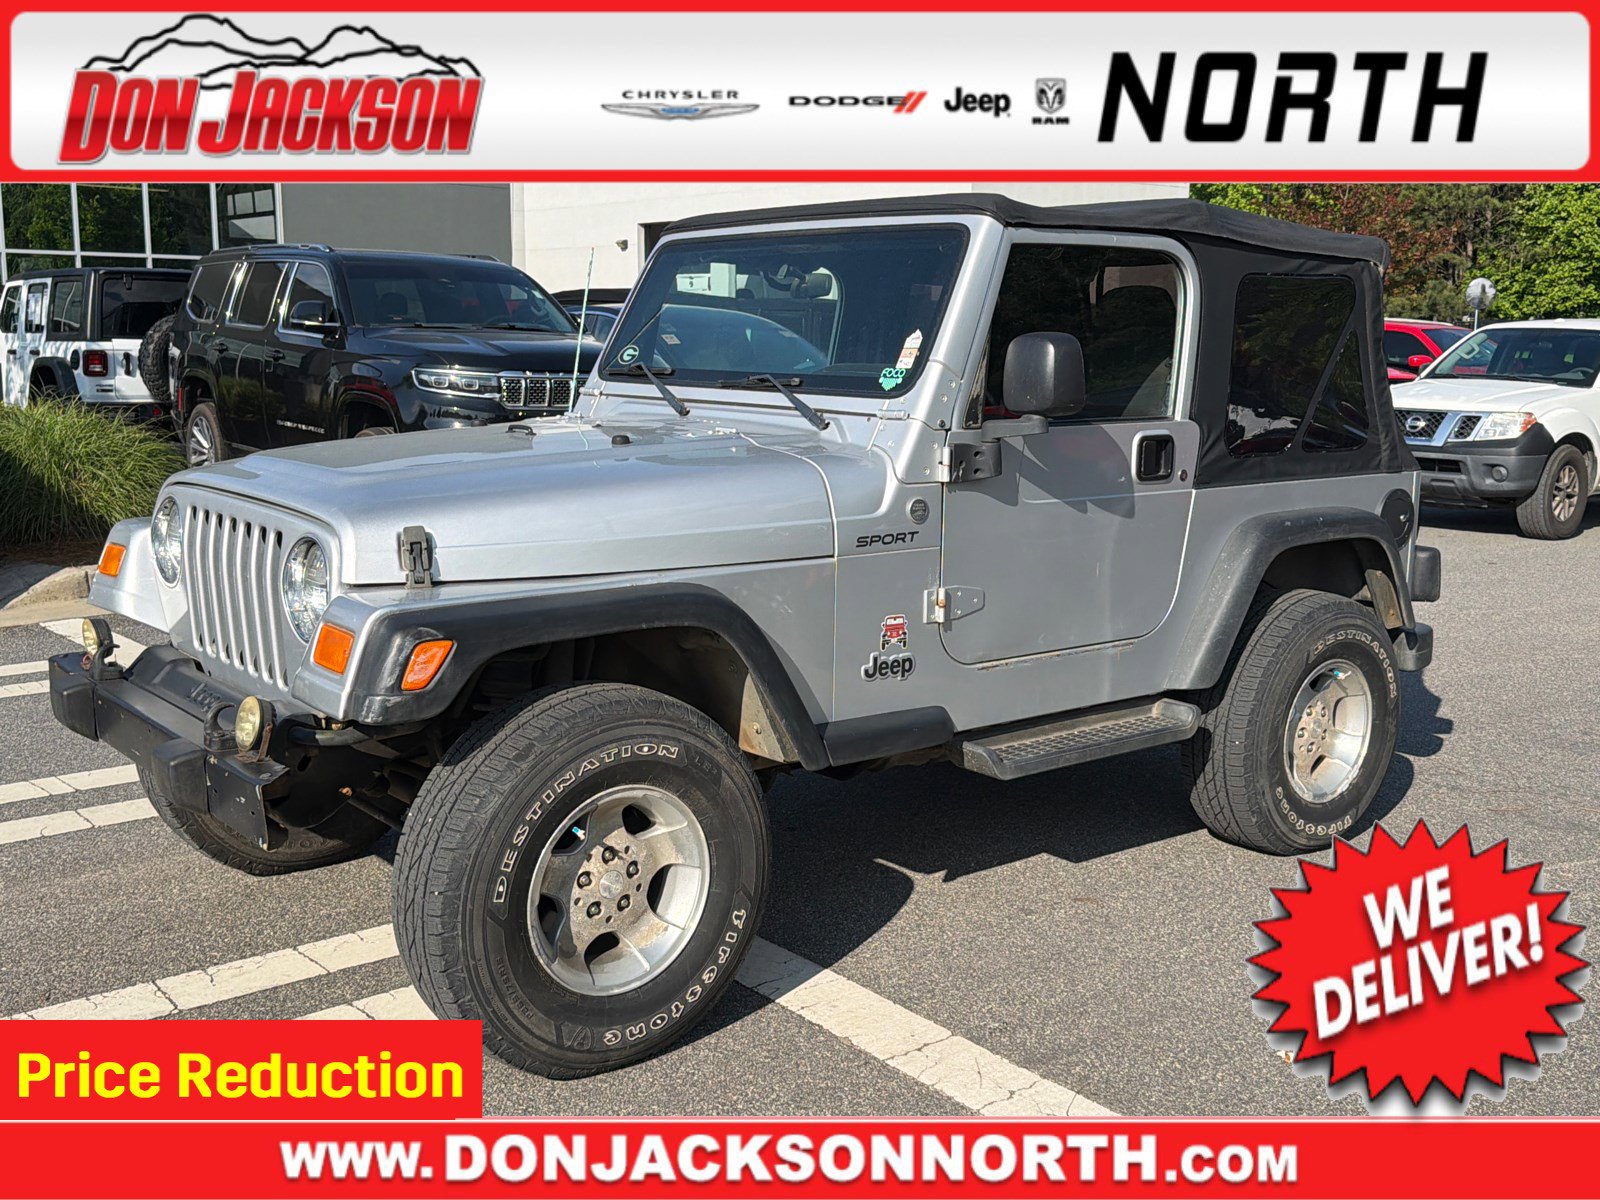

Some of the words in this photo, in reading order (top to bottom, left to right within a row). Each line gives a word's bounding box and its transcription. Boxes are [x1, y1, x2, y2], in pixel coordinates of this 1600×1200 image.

[880, 367, 906, 378] FOCO
[855, 530, 920, 549] SPORT
[861, 652, 916, 682] Jeep
[1313, 629, 1398, 698] DESTINATION
[493, 743, 679, 903] DESTINATION
[602, 909, 747, 1046] Firestone
